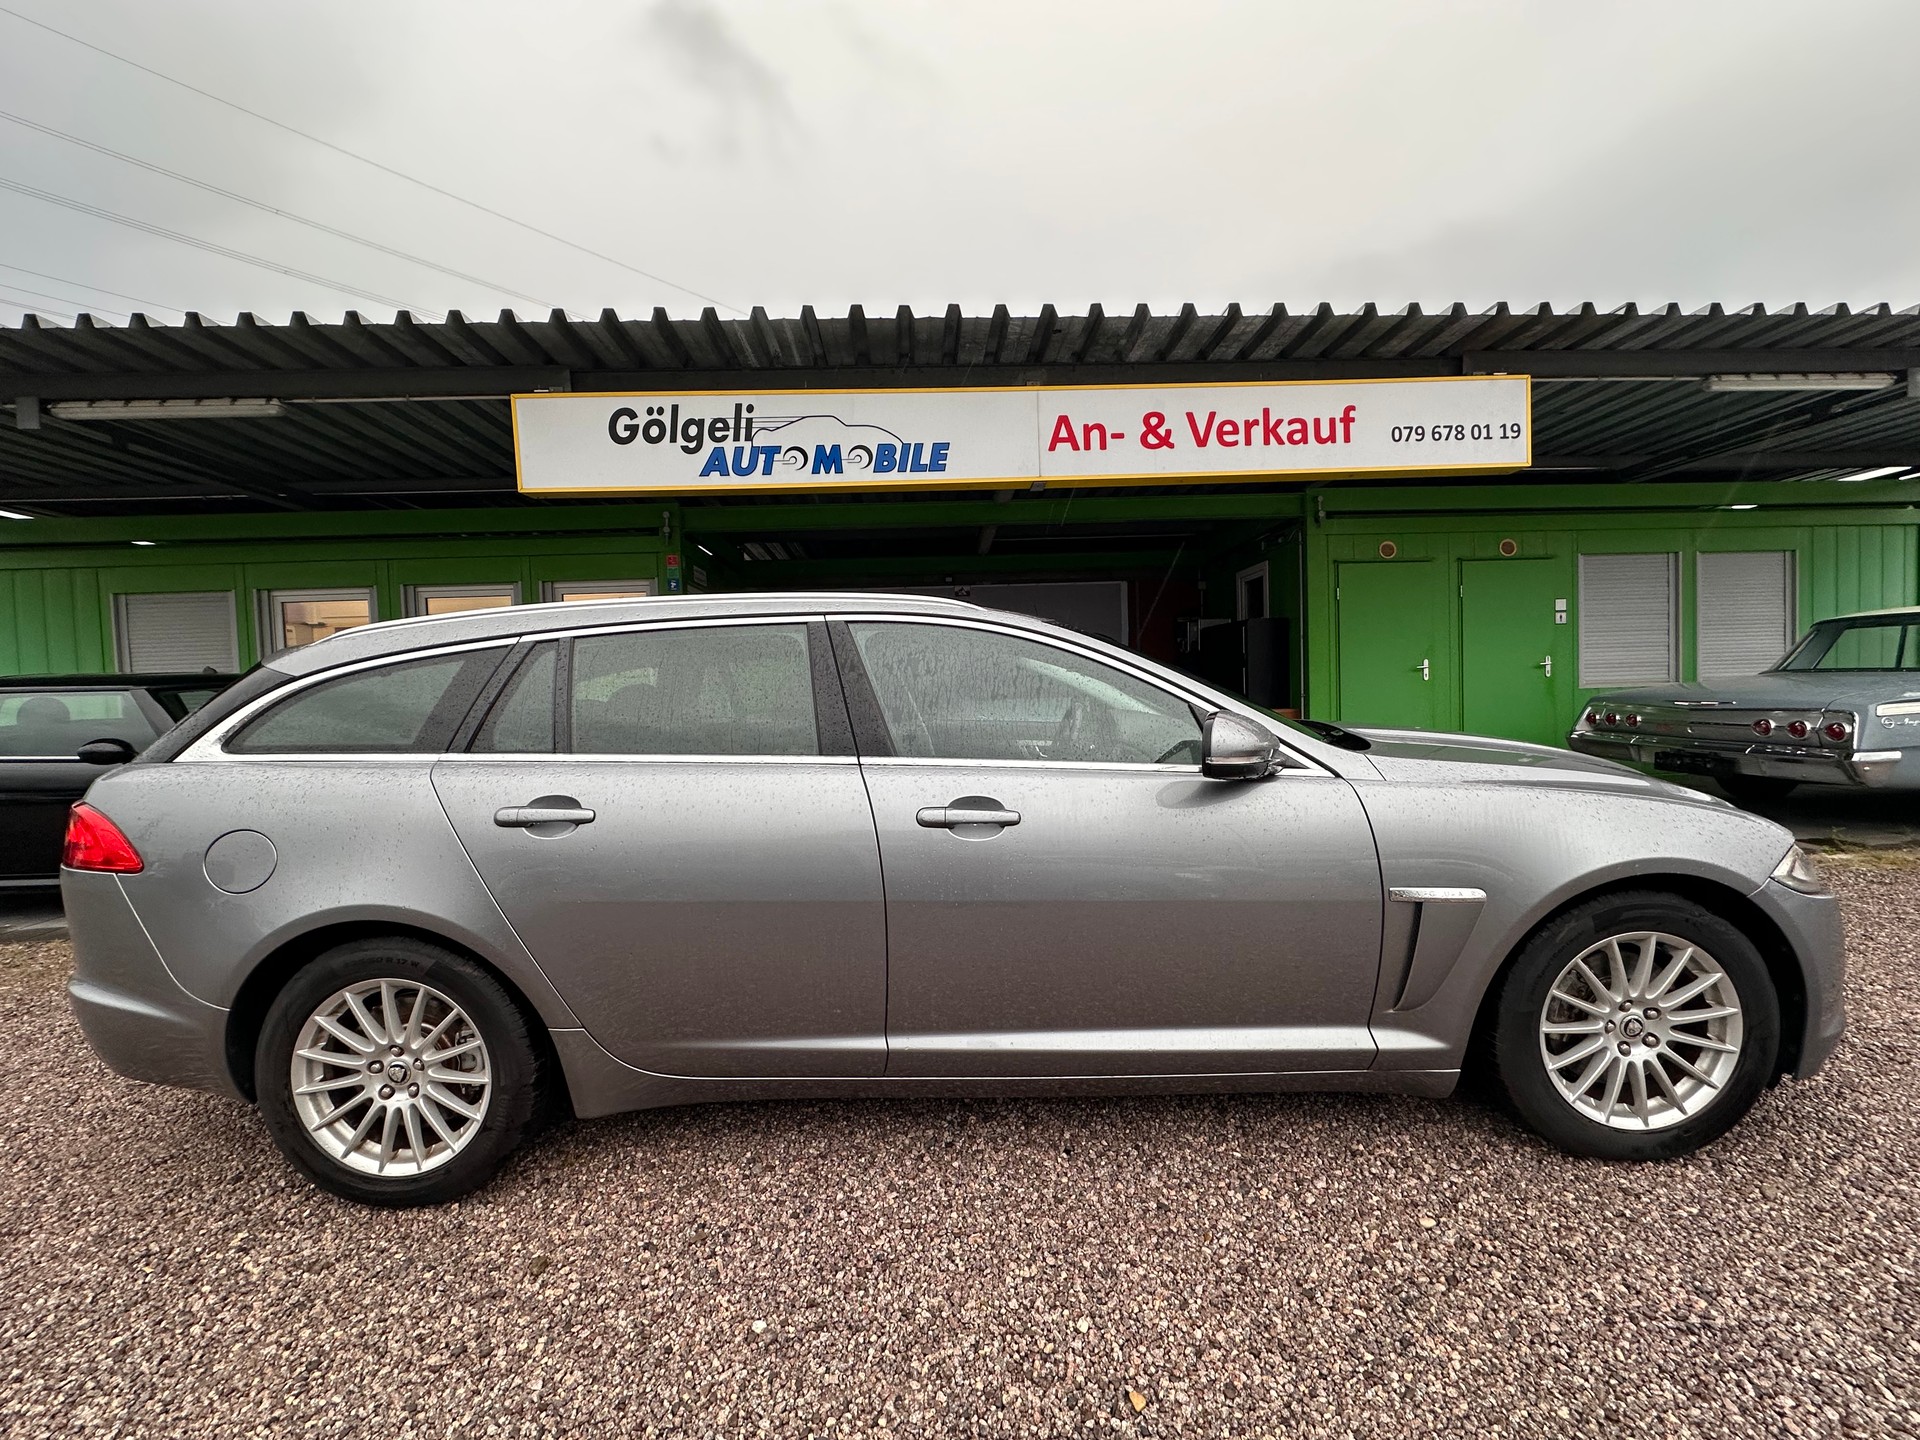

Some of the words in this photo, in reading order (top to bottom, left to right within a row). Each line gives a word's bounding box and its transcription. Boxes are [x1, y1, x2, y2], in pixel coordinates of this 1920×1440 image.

[608, 402, 755, 455] Gölgeli
[1047, 414, 1126, 453] An-
[1139, 410, 1176, 451] &
[1185, 404, 1357, 449] Verkauf
[1391, 425, 1426, 443] 079
[1431, 424, 1466, 442] 678
[1470, 423, 1493, 441] 01
[1499, 422, 1521, 440] 19
